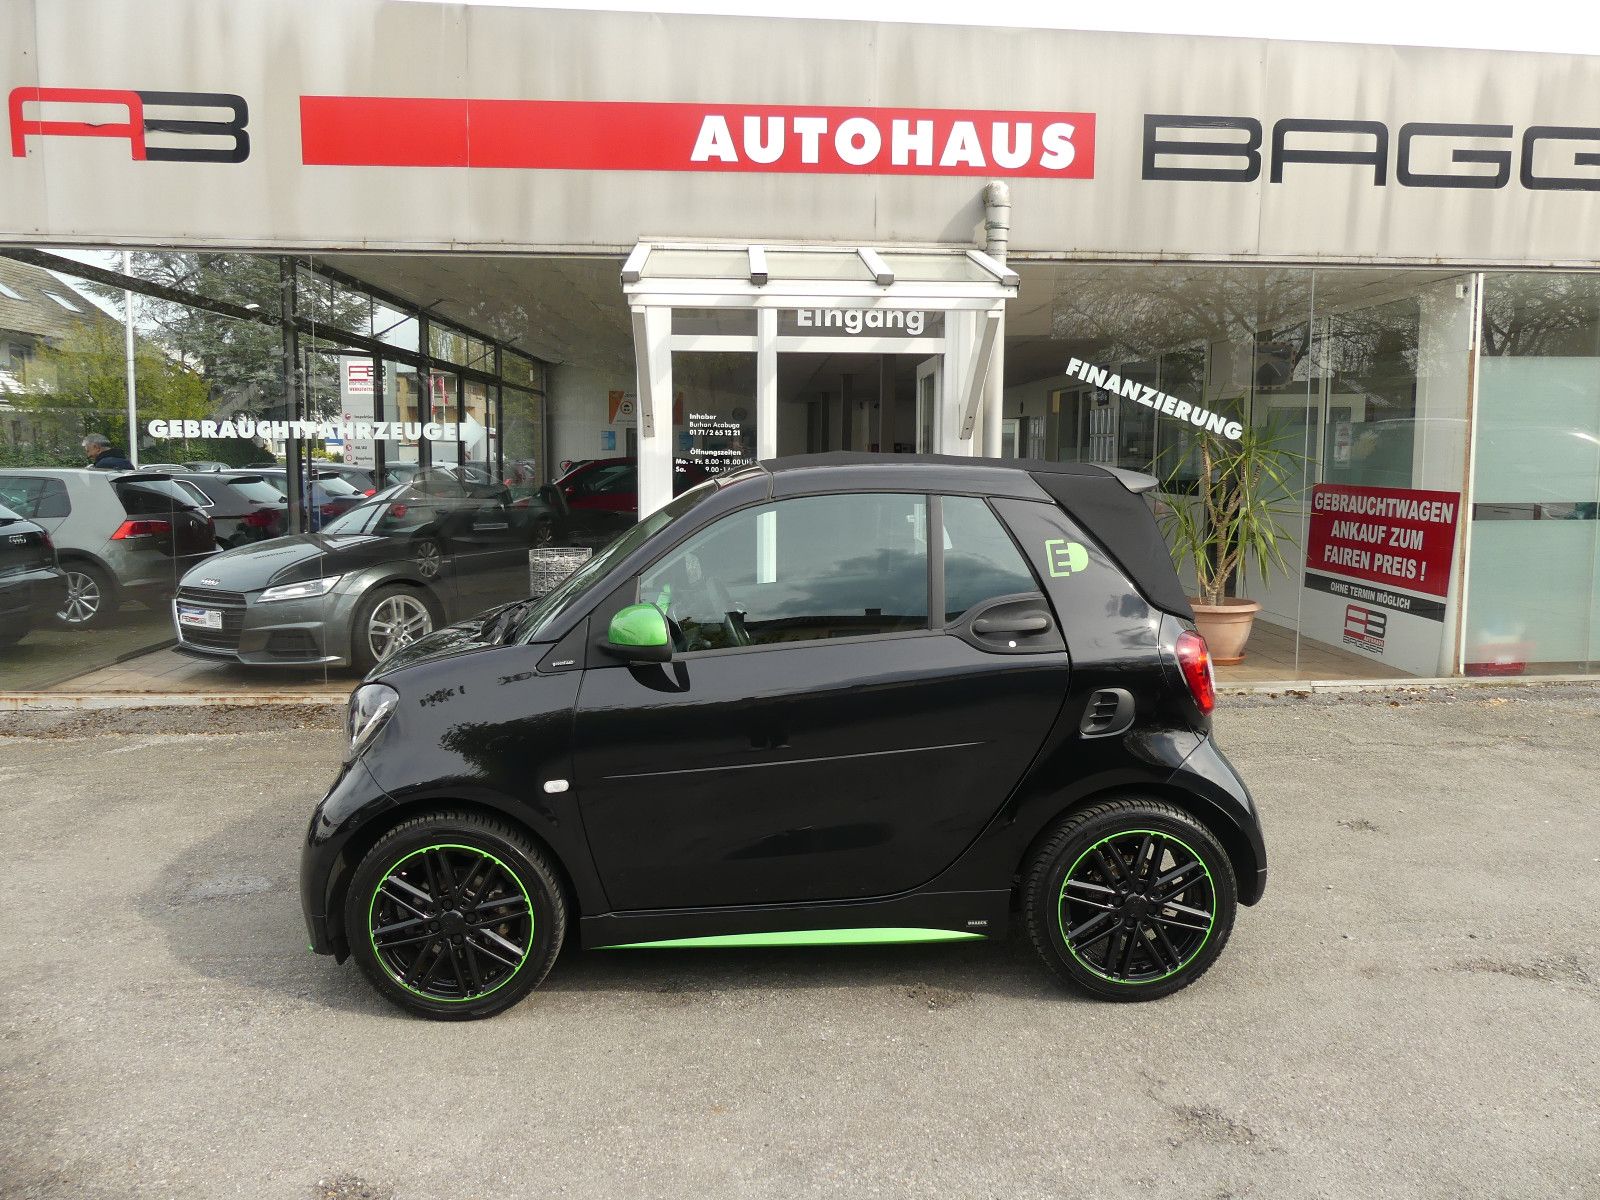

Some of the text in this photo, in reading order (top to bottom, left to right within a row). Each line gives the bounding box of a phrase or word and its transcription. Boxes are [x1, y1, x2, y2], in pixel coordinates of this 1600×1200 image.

[690, 115, 1076, 170] AUTOHAUS
[797, 309, 925, 335] Eingang
[1065, 357, 1243, 440] FINANZIERUNG
[148, 420, 457, 440] GEBRAUCHTFAHRZEUGE
[690, 448, 741, 456] Öffnungszeiten
[1314, 492, 1454, 524] GEBRAUCHTWAGEN
[1330, 520, 1424, 551] ANKAUF ZUM
[1324, 545, 1371, 570] FAIREN
[1373, 553, 1417, 580] PREIS
[1330, 581, 1411, 610] OHNE TERMIN MÖGLICH
